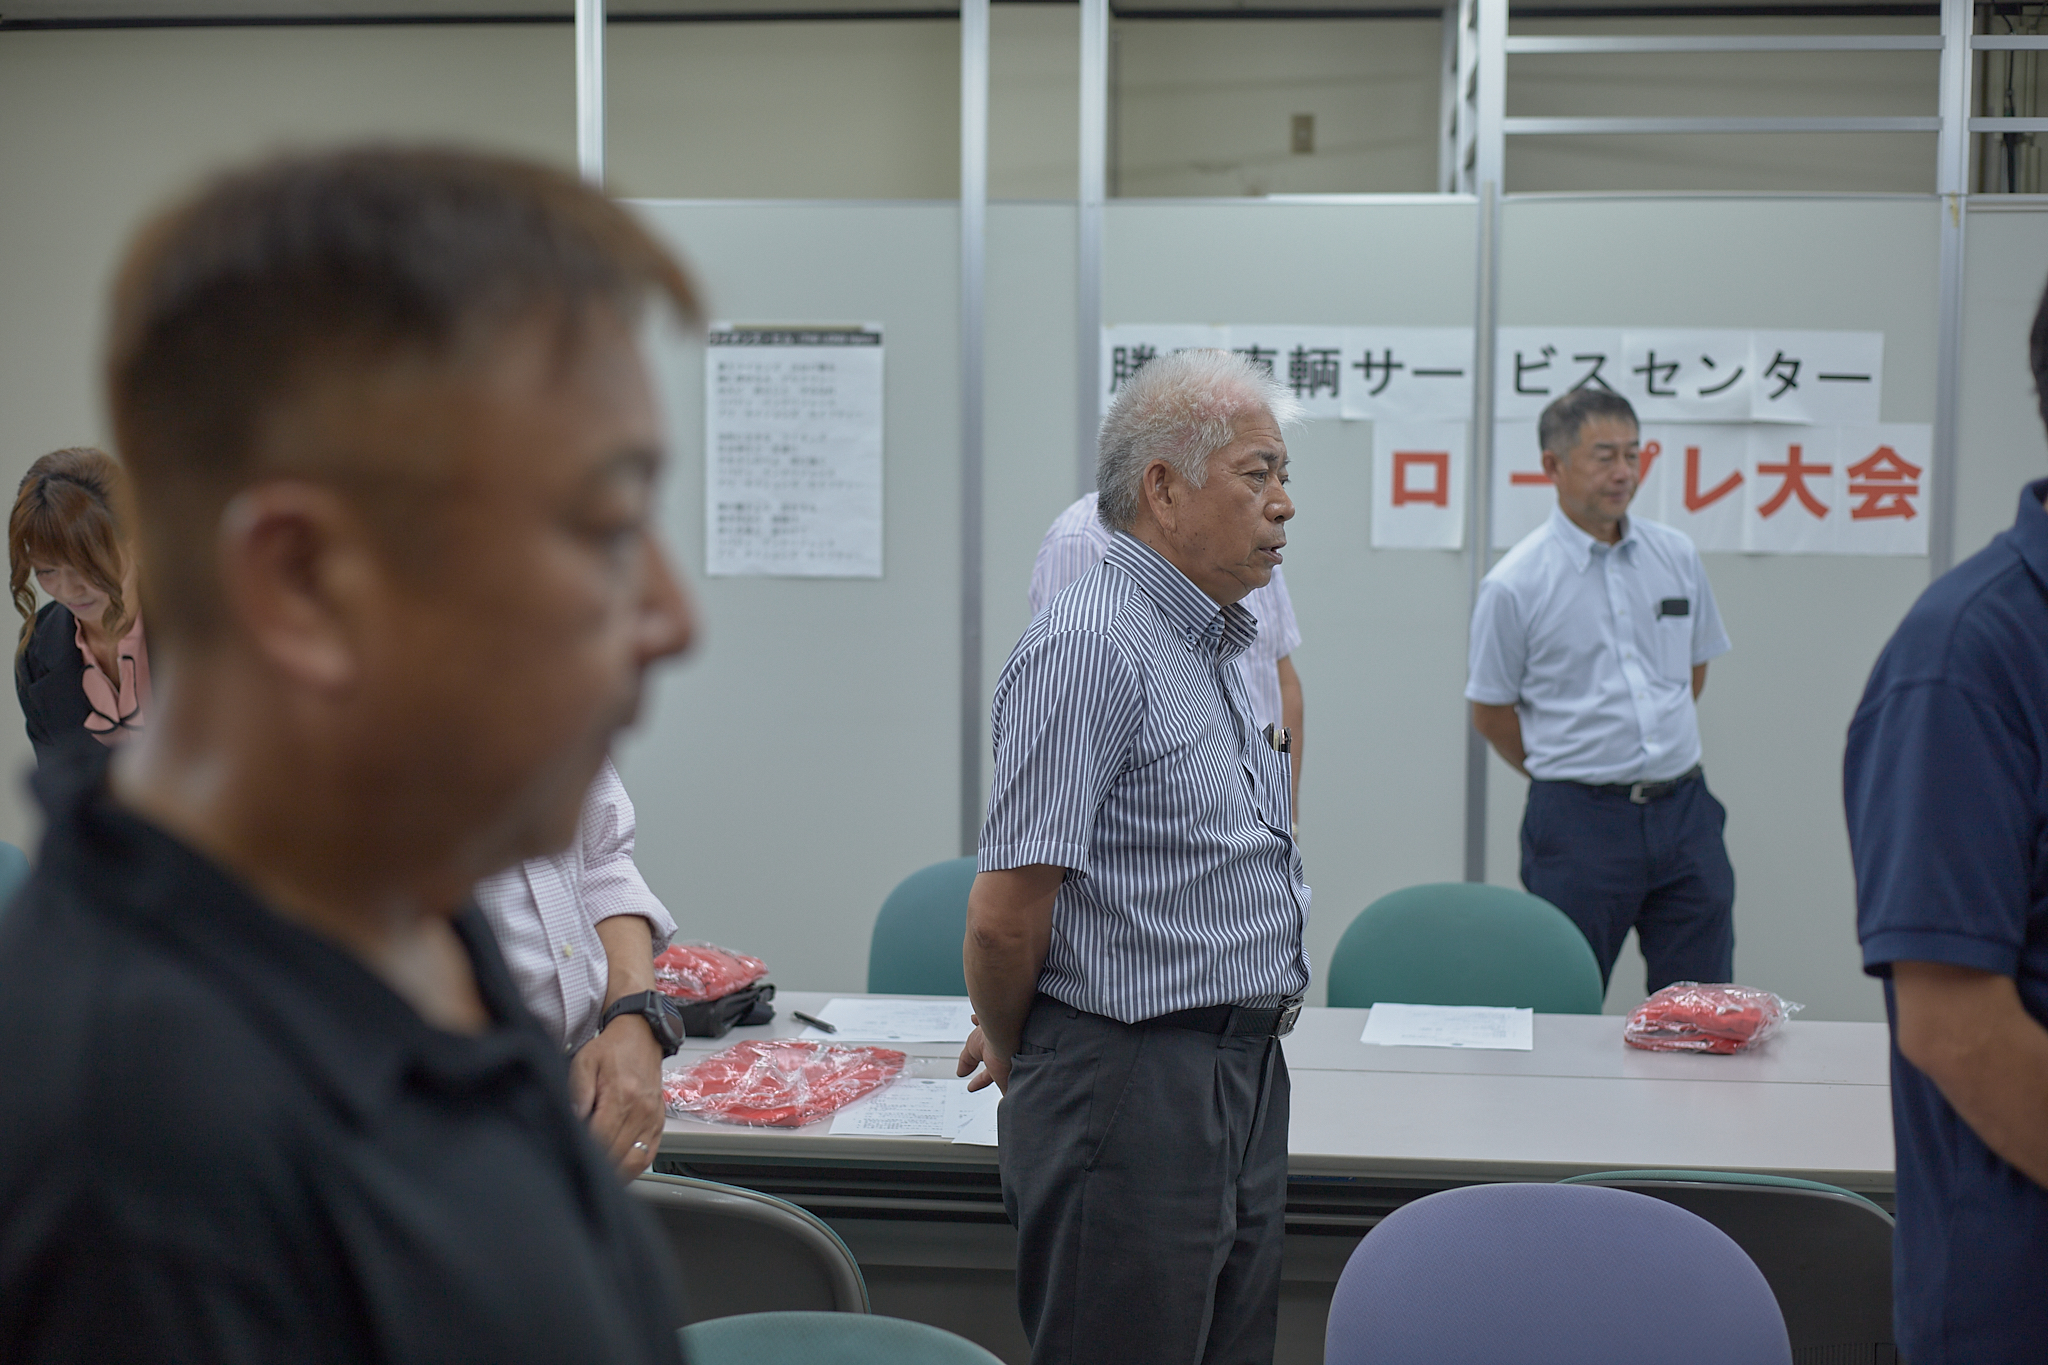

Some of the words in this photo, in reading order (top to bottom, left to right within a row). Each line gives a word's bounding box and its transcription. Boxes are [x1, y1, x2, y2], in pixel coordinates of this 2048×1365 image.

[1109, 344, 1872, 400] 勝輌サービスセンター
